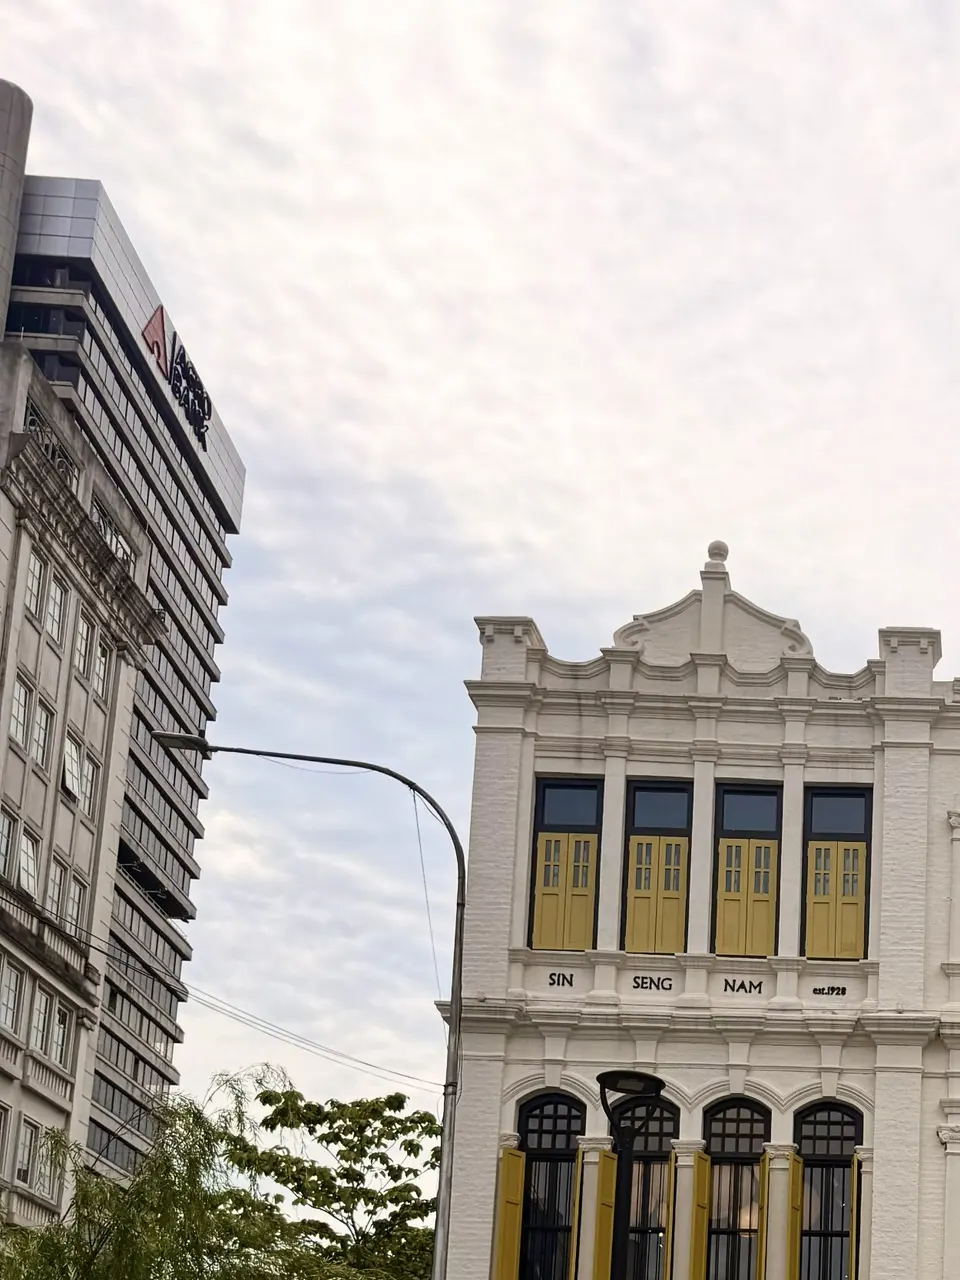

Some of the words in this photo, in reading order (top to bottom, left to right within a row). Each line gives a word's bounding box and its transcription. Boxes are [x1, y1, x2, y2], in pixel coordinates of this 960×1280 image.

[549, 973, 574, 987] SIN
[632, 976, 673, 990] SENG
[723, 978, 763, 994] NAM
[813, 986, 847, 996] est.1928
